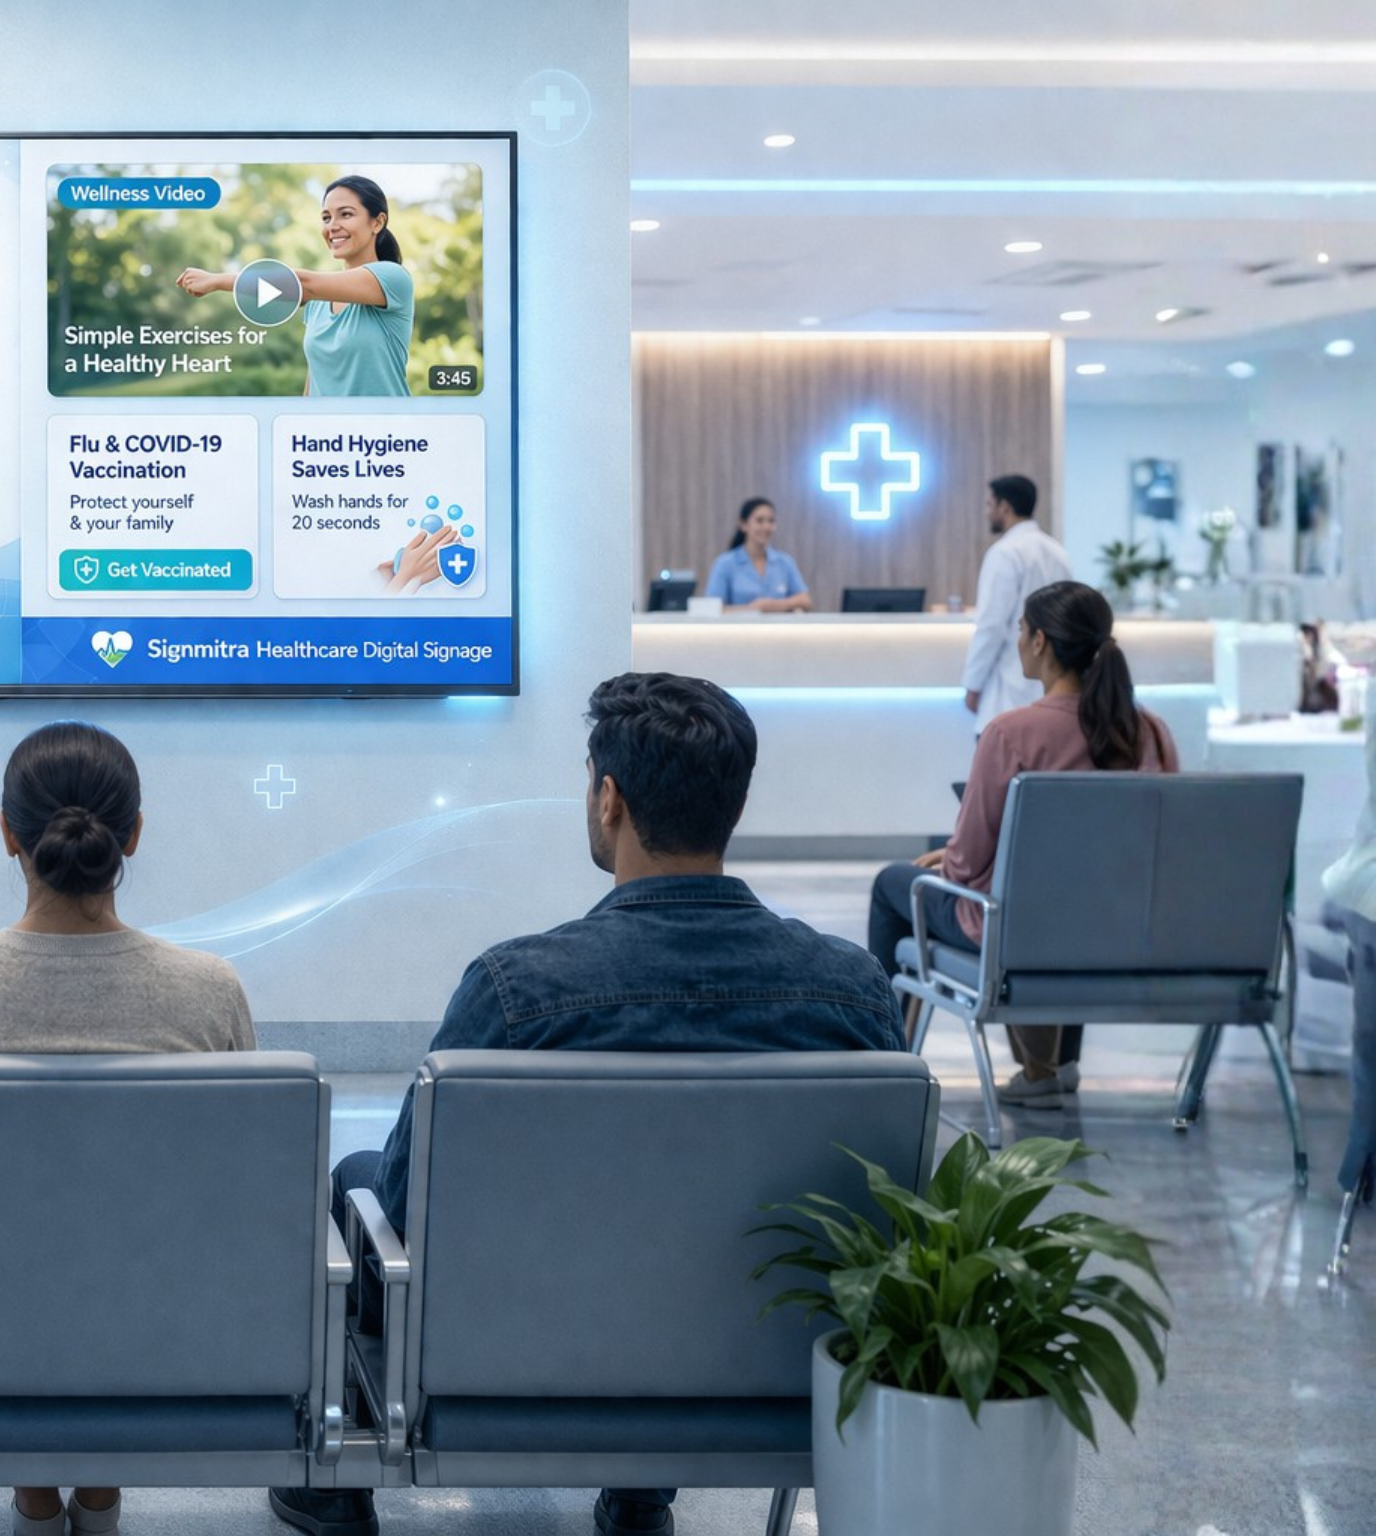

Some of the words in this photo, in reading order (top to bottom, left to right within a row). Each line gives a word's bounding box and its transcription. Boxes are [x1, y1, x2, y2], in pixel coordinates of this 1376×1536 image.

[70, 185, 150, 202] Wellness
[154, 185, 206, 202] Video
[65, 325, 134, 347] Simple
[140, 325, 233, 345] Exercises
[237, 325, 268, 346] for
[64, 358, 77, 373] a
[84, 353, 167, 378] Healthy
[172, 353, 232, 373] Heart
[437, 371, 471, 385] 3:45
[70, 434, 100, 453] Flu
[105, 434, 121, 453] &
[125, 434, 222, 453] COVID-19
[292, 434, 343, 453] Hand
[348, 434, 429, 457] Hygiene
[69, 460, 186, 479] Vaccination
[292, 459, 350, 478] Saves
[355, 459, 405, 478] Lives
[70, 494, 128, 510] Protect
[131, 493, 195, 513] yourself
[291, 494, 334, 509] Wash
[338, 493, 383, 509] hands
[386, 493, 409, 509] for
[69, 515, 82, 531] &
[85, 519, 122, 534] your
[126, 514, 174, 534] family
[292, 514, 313, 530] 20
[316, 514, 381, 530] seconds
[107, 561, 138, 577] Get
[141, 561, 231, 577] Vaccinated
[147, 638, 249, 664] Signmitra
[256, 640, 358, 658] Healthcare
[363, 641, 418, 663] Digital
[423, 641, 493, 663] Signage
